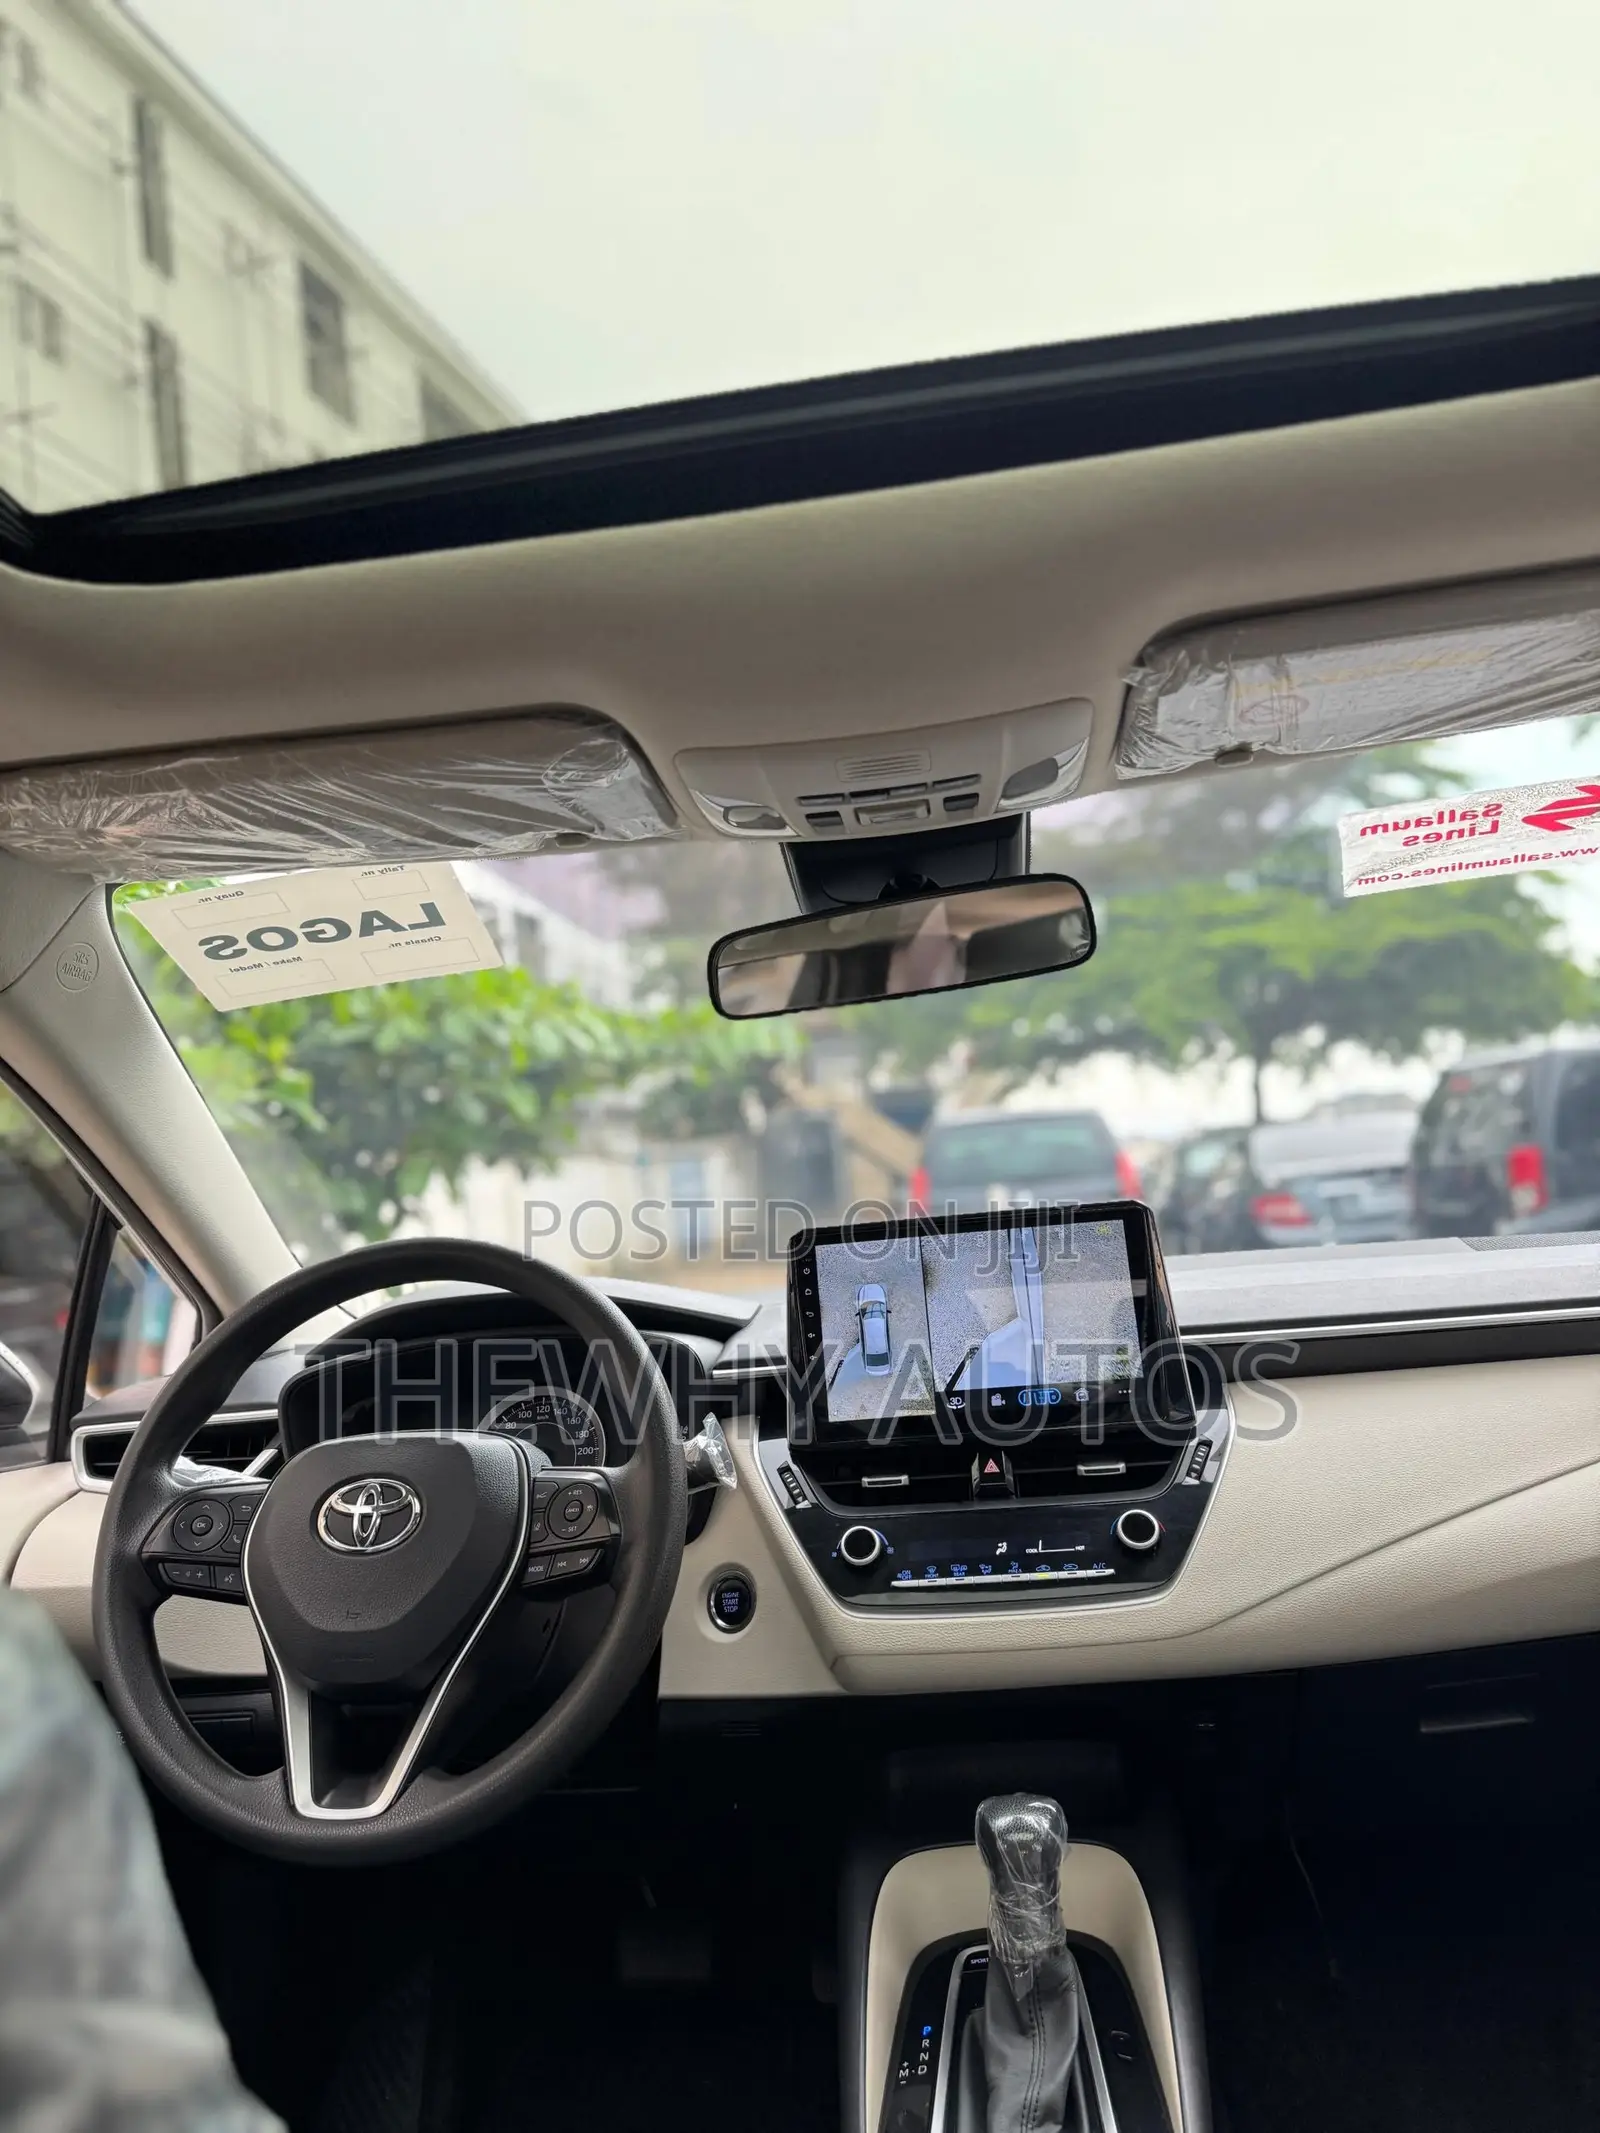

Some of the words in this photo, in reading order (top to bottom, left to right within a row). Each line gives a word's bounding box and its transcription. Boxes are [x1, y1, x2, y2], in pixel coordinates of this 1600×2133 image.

[60, 961, 93, 982] AIRBAG
[536, 1405, 550, 1414] 120
[553, 1407, 568, 1416] 140
[518, 1410, 532, 1419] 100
[566, 1416, 581, 1425] 160
[505, 1421, 517, 1430] 80
[575, 1430, 590, 1439] 180
[577, 1447, 593, 1456] 200
[528, 1565, 544, 1573] MODE
[722, 1598, 739, 1606] START
[923, 2025, 932, 2036] P
[922, 2039, 930, 2048] R
[920, 2052, 929, 2061] N
[899, 2068, 909, 2078] M
[918, 2065, 927, 2075] D
